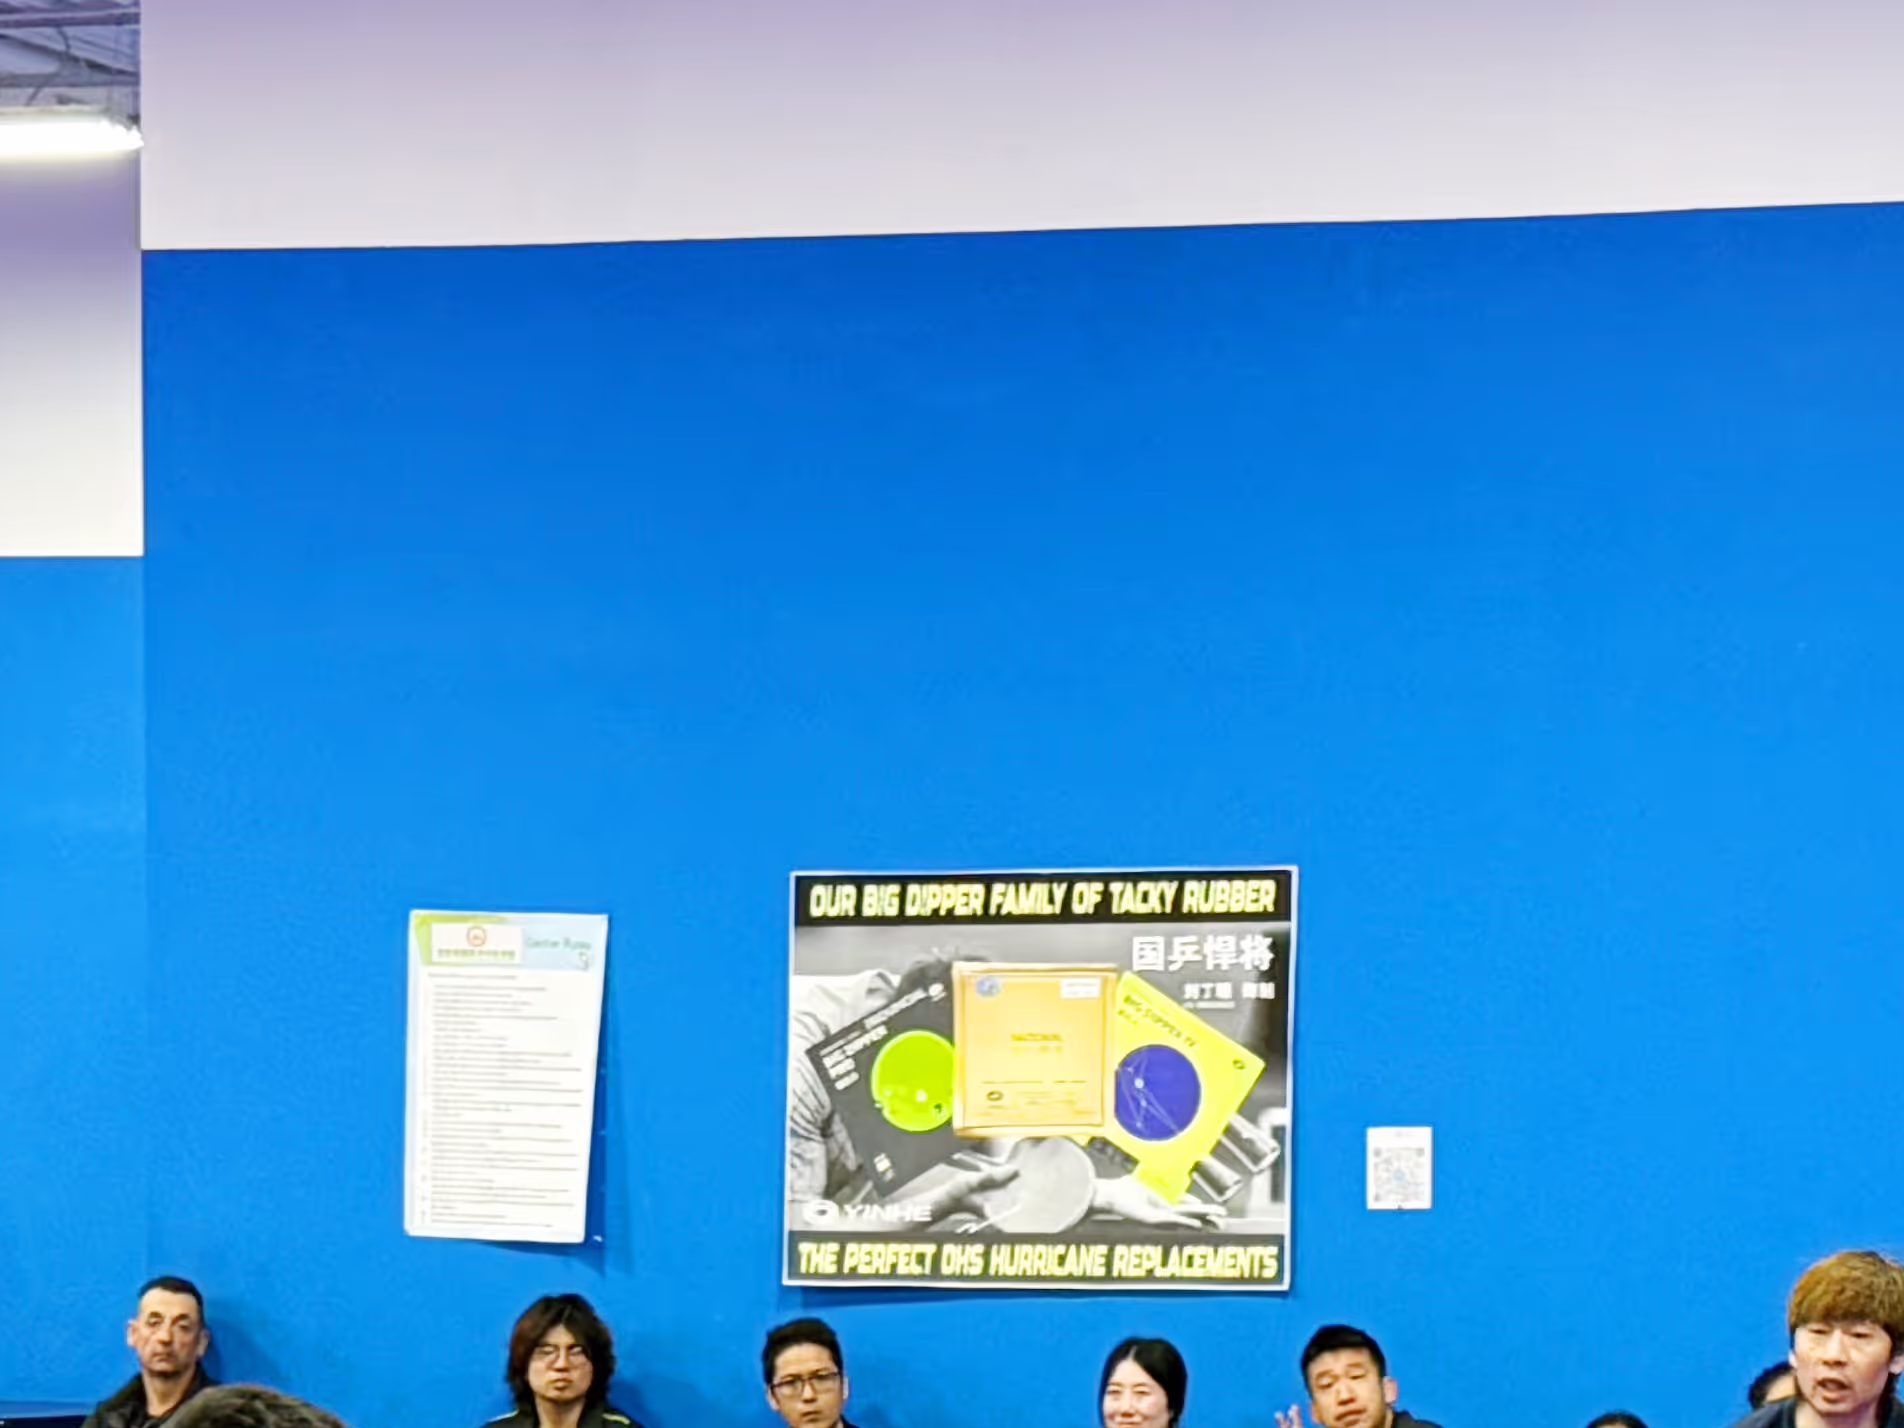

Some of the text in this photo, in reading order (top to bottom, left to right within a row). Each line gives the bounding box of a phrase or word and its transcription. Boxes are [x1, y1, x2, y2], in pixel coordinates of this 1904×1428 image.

[809, 879, 1277, 917] OUR BIG DIPPER FAMILY OF TACKY RUBBER
[845, 1203, 933, 1222] YINHE
[798, 1242, 841, 1274] THE
[843, 1242, 938, 1275] PERFECT
[989, 1243, 1108, 1277] HURRICANE
[1112, 1244, 1279, 1279] REPLACEMENTS
